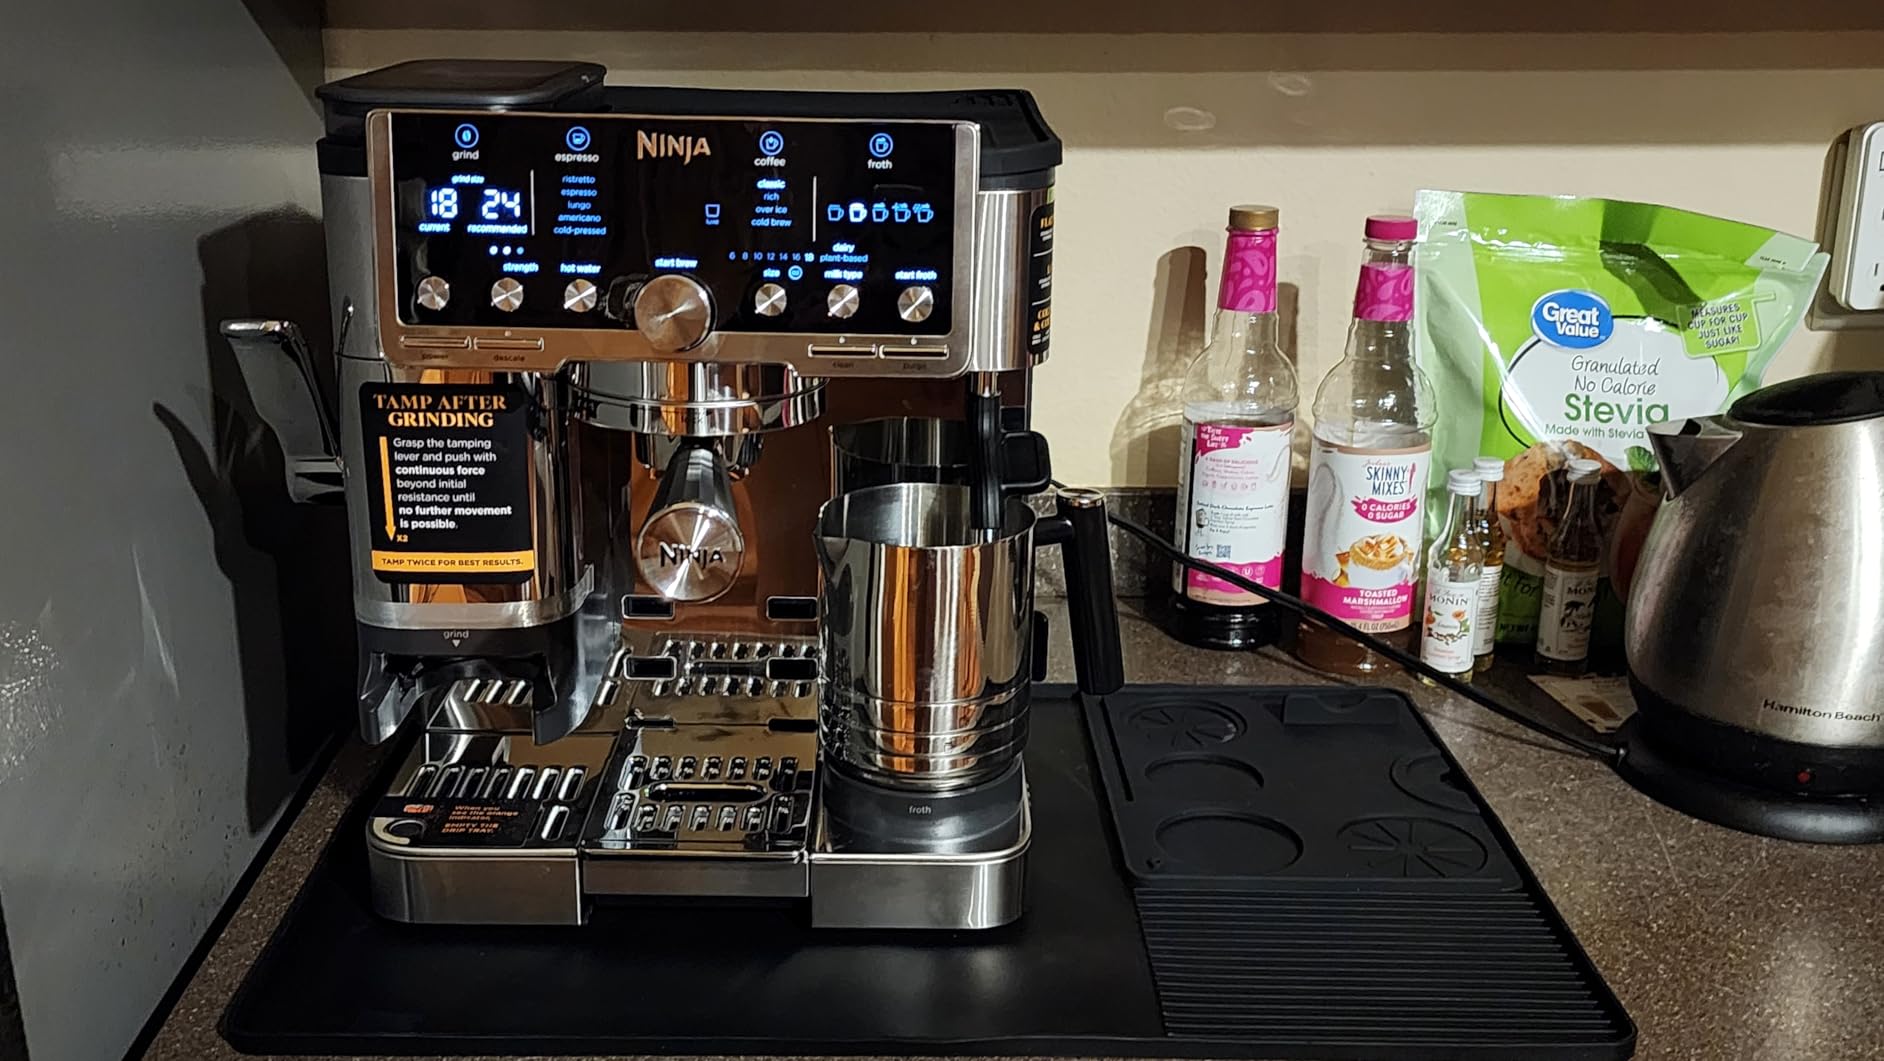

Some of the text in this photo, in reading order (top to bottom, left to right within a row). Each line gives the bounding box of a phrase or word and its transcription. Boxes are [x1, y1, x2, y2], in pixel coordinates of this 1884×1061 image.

[637, 130, 711, 165] NINJA
[452, 150, 479, 161] grind
[555, 153, 599, 163] espresso
[754, 156, 786, 167] coffee
[867, 159, 892, 170] froth
[562, 175, 596, 184] ristretto
[561, 189, 597, 198] espresso
[764, 192, 780, 201] rich
[431, 188, 520, 219] 18 24
[568, 200, 591, 210] lungo
[775, 205, 788, 214] ice
[558, 213, 601, 222] americano
[751, 217, 792, 227] cold brew
[419, 222, 451, 233] current
[467, 224, 528, 235] recommended
[553, 226, 607, 235] cold-pressed
[832, 242, 855, 253] dairy
[729, 251, 736, 260] 6
[742, 251, 748, 260] 8
[753, 252, 763, 261] 10
[767, 252, 775, 261] 12
[779, 252, 788, 261] 14
[792, 252, 801, 261] 16
[820, 253, 869, 263] plant-based
[503, 262, 539, 273] strength
[560, 263, 601, 274] hot water
[1542, 302, 1600, 327] Great
[1691, 303, 1740, 318] MEASURES
[1687, 312, 1748, 329] CUP FOR CUP
[1556, 321, 1599, 338] Value
[1698, 324, 1743, 339] JUST LIKE
[1572, 355, 1662, 376] Granulated
[1574, 375, 1656, 396] No Calorie
[373, 394, 507, 411] TAMP AFTER
[1564, 393, 1669, 425] Stevia
[388, 411, 494, 428] GRINDING
[1544, 423, 1645, 439] Made with Stevia
[393, 437, 492, 450] Grasp the tamping
[394, 452, 497, 463] lever and push with
[395, 465, 486, 476] continuous force
[1366, 465, 1408, 481] SKINNY
[396, 479, 467, 491] beyond initial
[1372, 481, 1405, 496] MIXES
[397, 492, 476, 502] resistance until
[399, 505, 512, 516] no further movement
[1369, 502, 1411, 512] CALORIES
[1375, 511, 1404, 520] SUGAR
[399, 519, 458, 530] is possible.
[658, 541, 726, 570] NINJA
[382, 558, 524, 567] TAMP TWICE FOR BEST RESULTS.
[1360, 588, 1398, 598] TOASTED
[1343, 594, 1408, 605] MARSHMALLOW
[443, 630, 469, 639] grind
[1763, 699, 1881, 722] Hamilton Beach
[908, 805, 932, 815] froth
